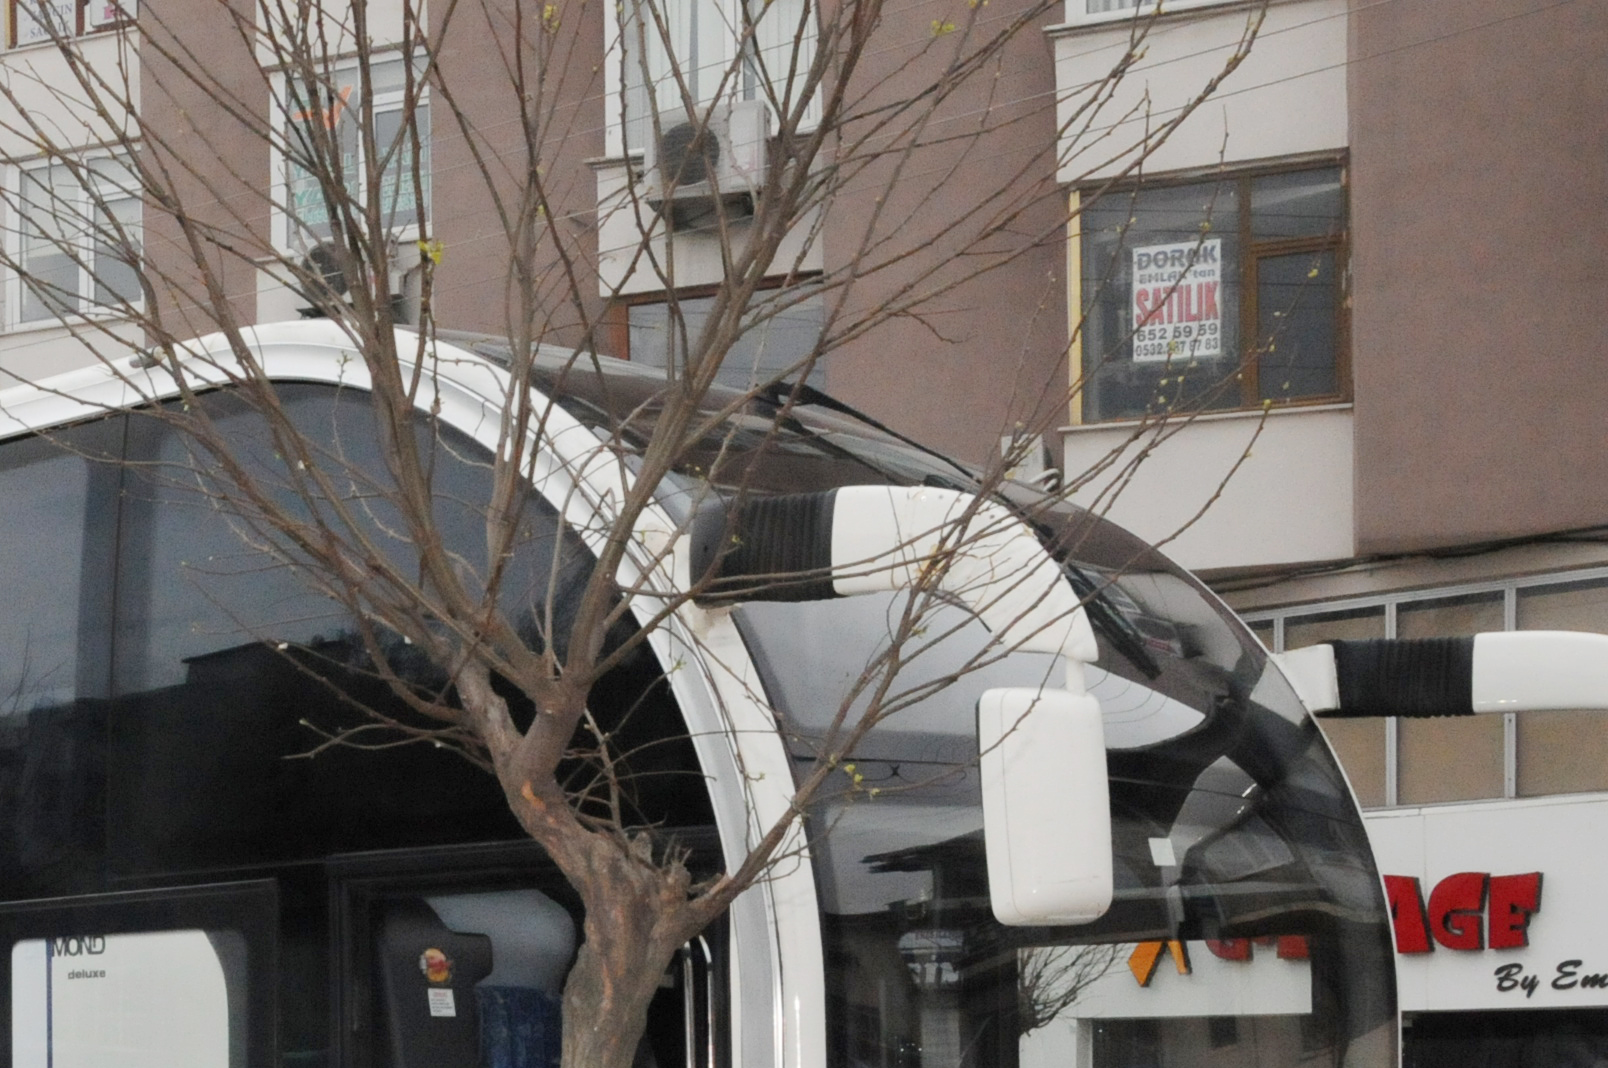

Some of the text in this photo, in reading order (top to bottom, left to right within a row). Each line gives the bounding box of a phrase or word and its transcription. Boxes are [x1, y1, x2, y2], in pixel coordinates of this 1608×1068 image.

[1135, 280, 1220, 328] SATILIK
[1137, 322, 1219, 343] 652 59 59
[67, 969, 106, 980] deluxe
[1494, 963, 1540, 998] By
